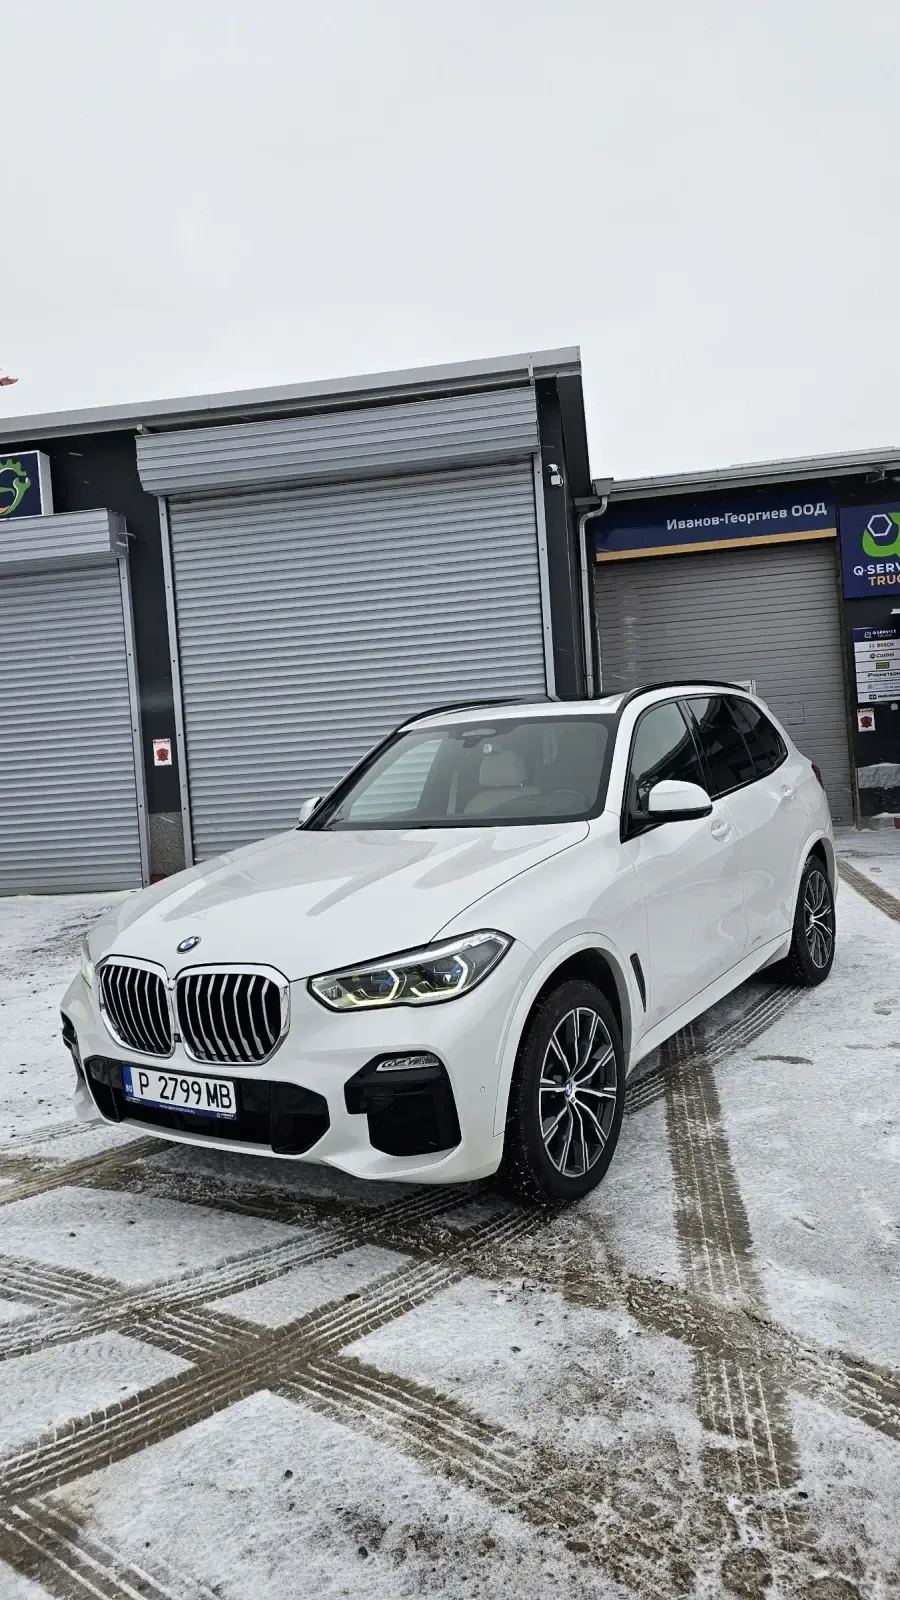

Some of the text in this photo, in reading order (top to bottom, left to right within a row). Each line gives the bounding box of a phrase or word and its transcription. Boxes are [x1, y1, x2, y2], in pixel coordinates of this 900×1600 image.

[666, 502, 828, 530] Иванов-Георгиев ООД
[138, 1071, 232, 1108] P 2799 MB
